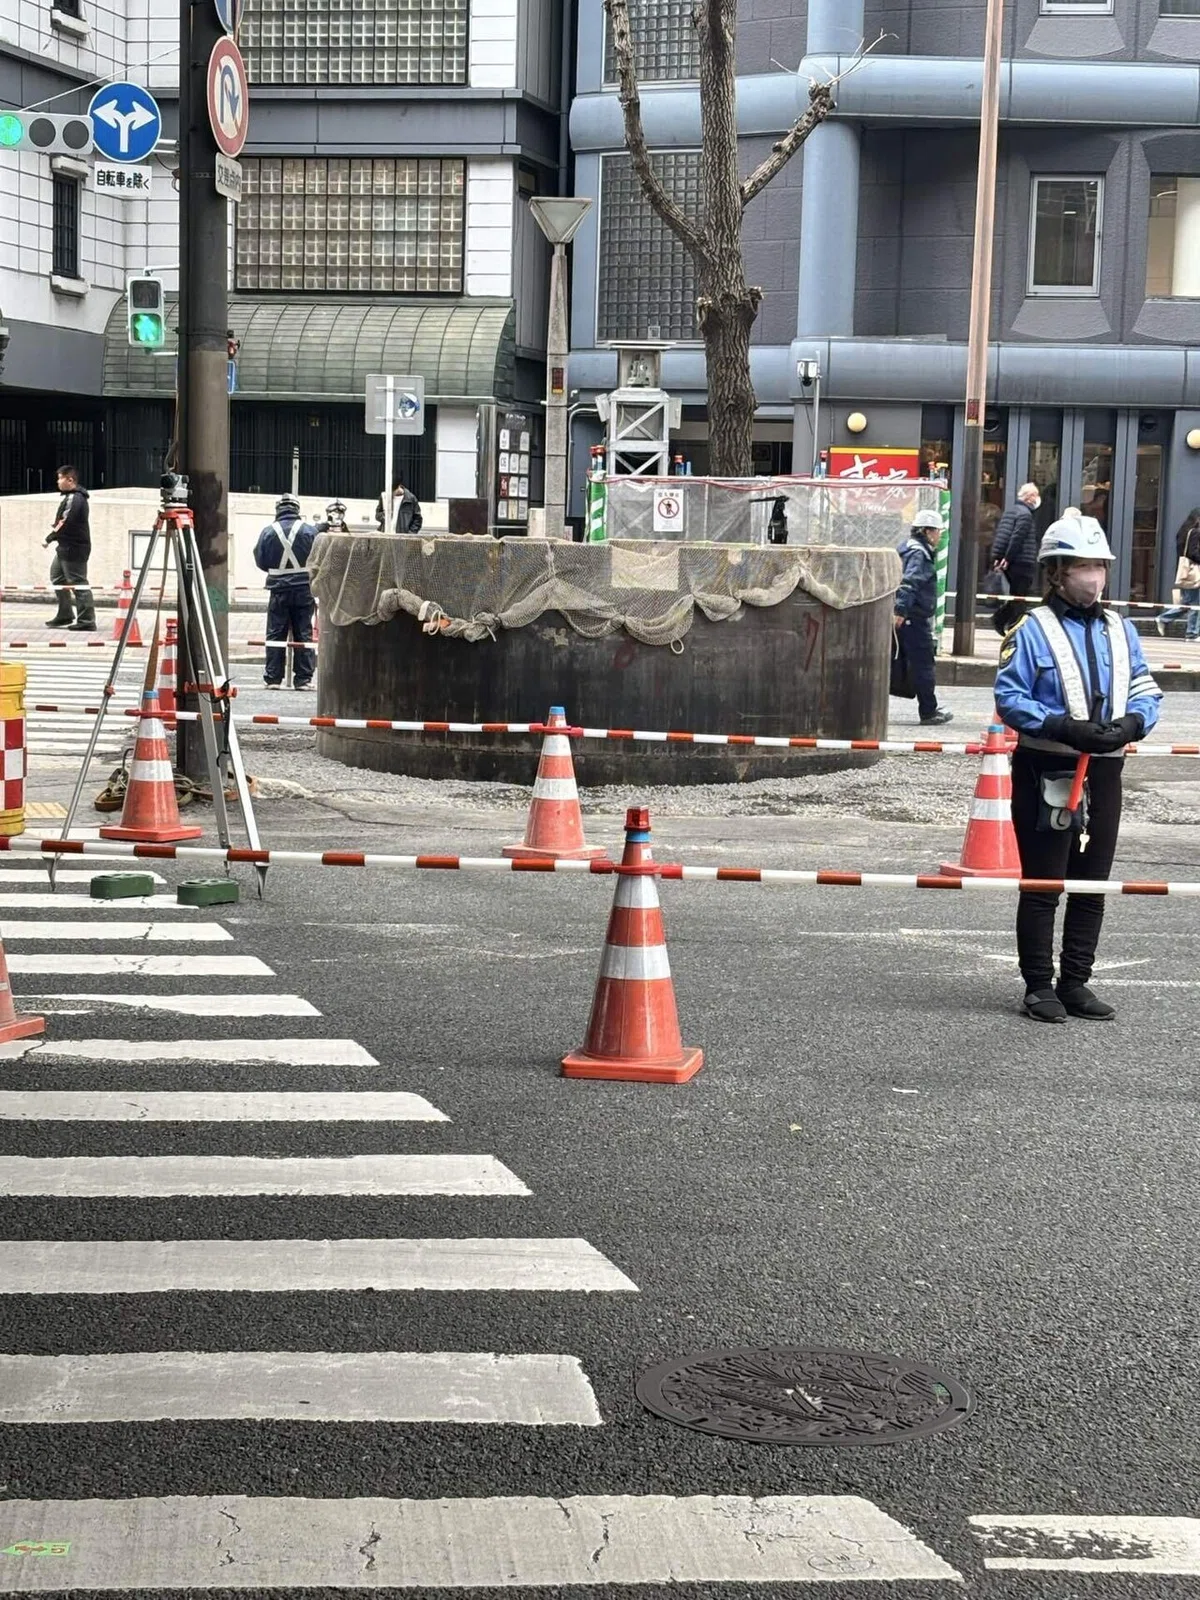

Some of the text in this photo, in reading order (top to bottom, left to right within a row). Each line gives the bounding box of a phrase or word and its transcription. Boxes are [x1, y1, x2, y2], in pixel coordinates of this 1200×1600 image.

[96, 169, 150, 190] 自転車を除く
